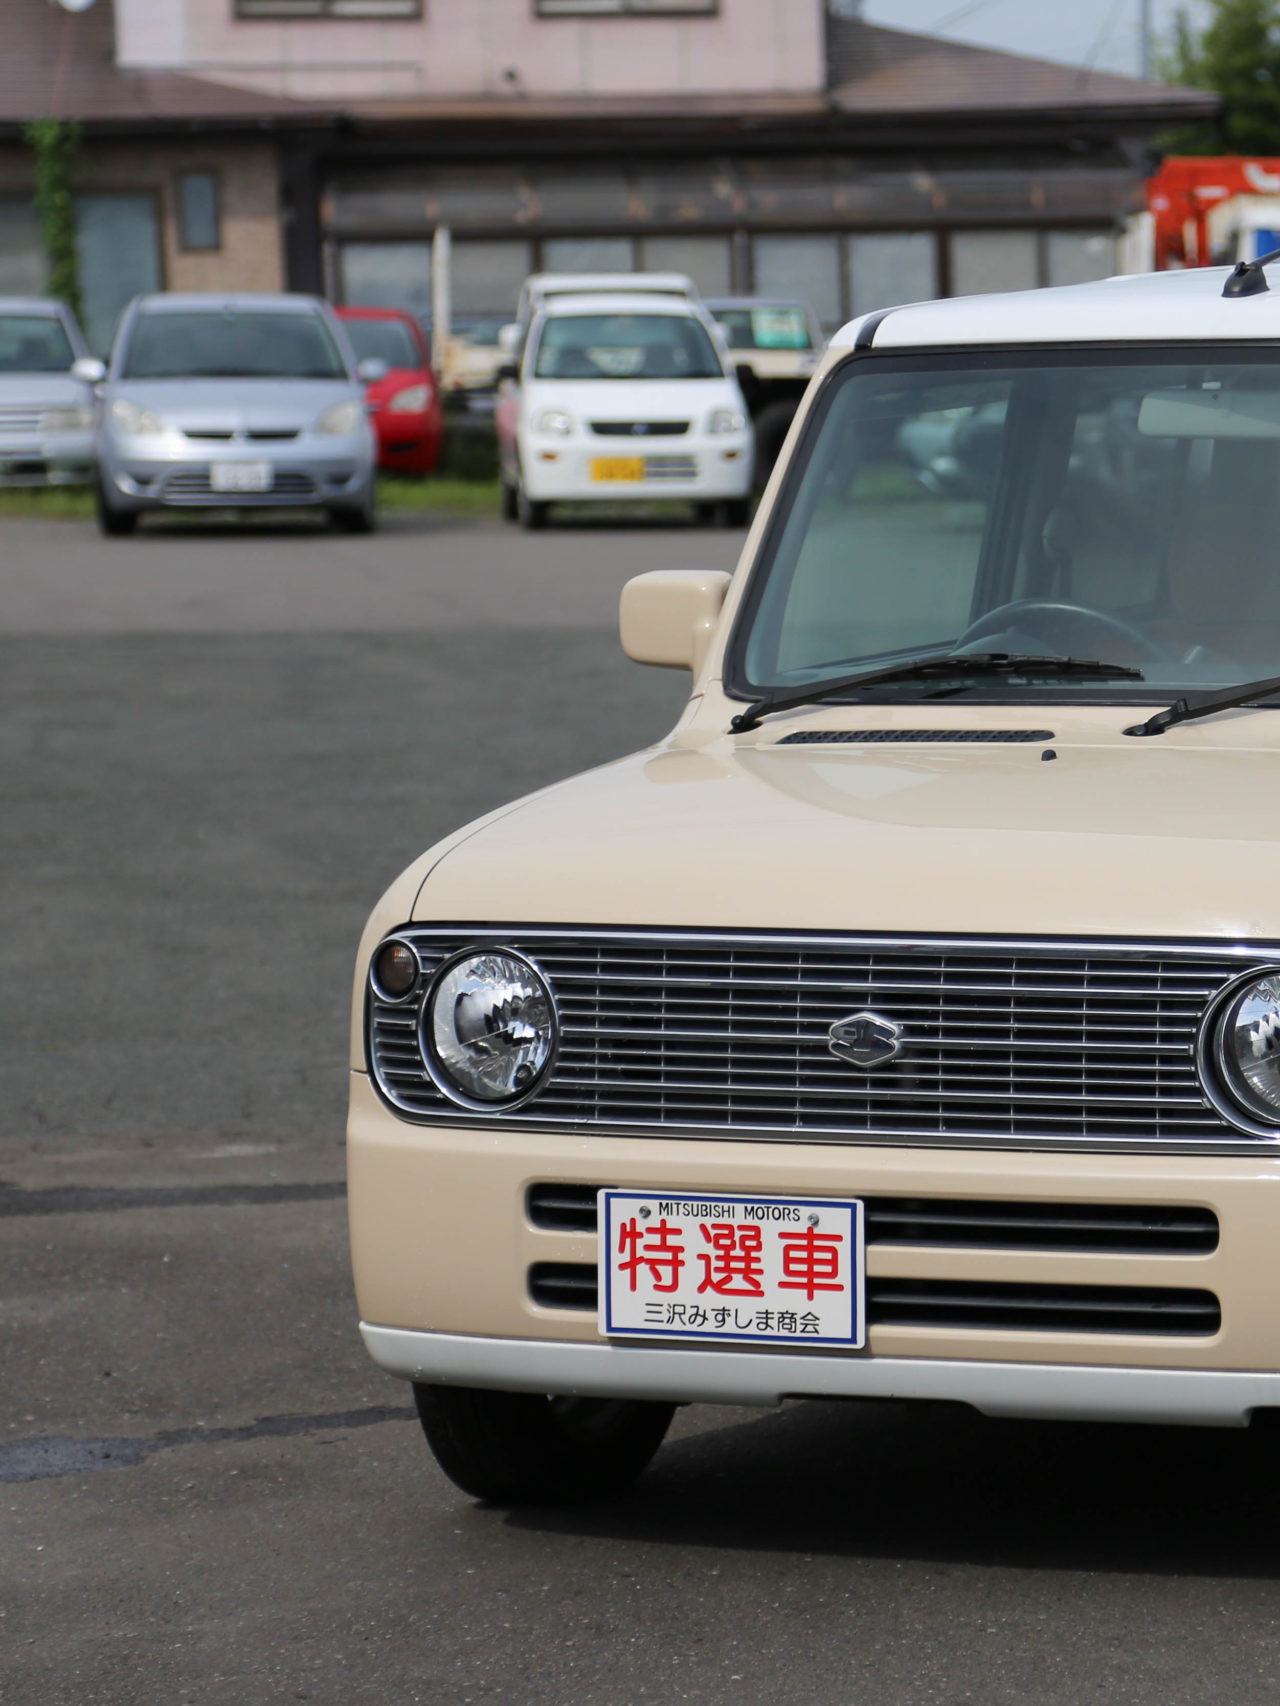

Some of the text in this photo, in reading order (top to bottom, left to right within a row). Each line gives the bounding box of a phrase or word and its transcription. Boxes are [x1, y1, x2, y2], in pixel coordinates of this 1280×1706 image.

[658, 1202, 801, 1222] MITSUBISHI MOTORS
[618, 1217, 845, 1301] 特選車
[644, 1302, 820, 1335] 三沢みずしま商会
